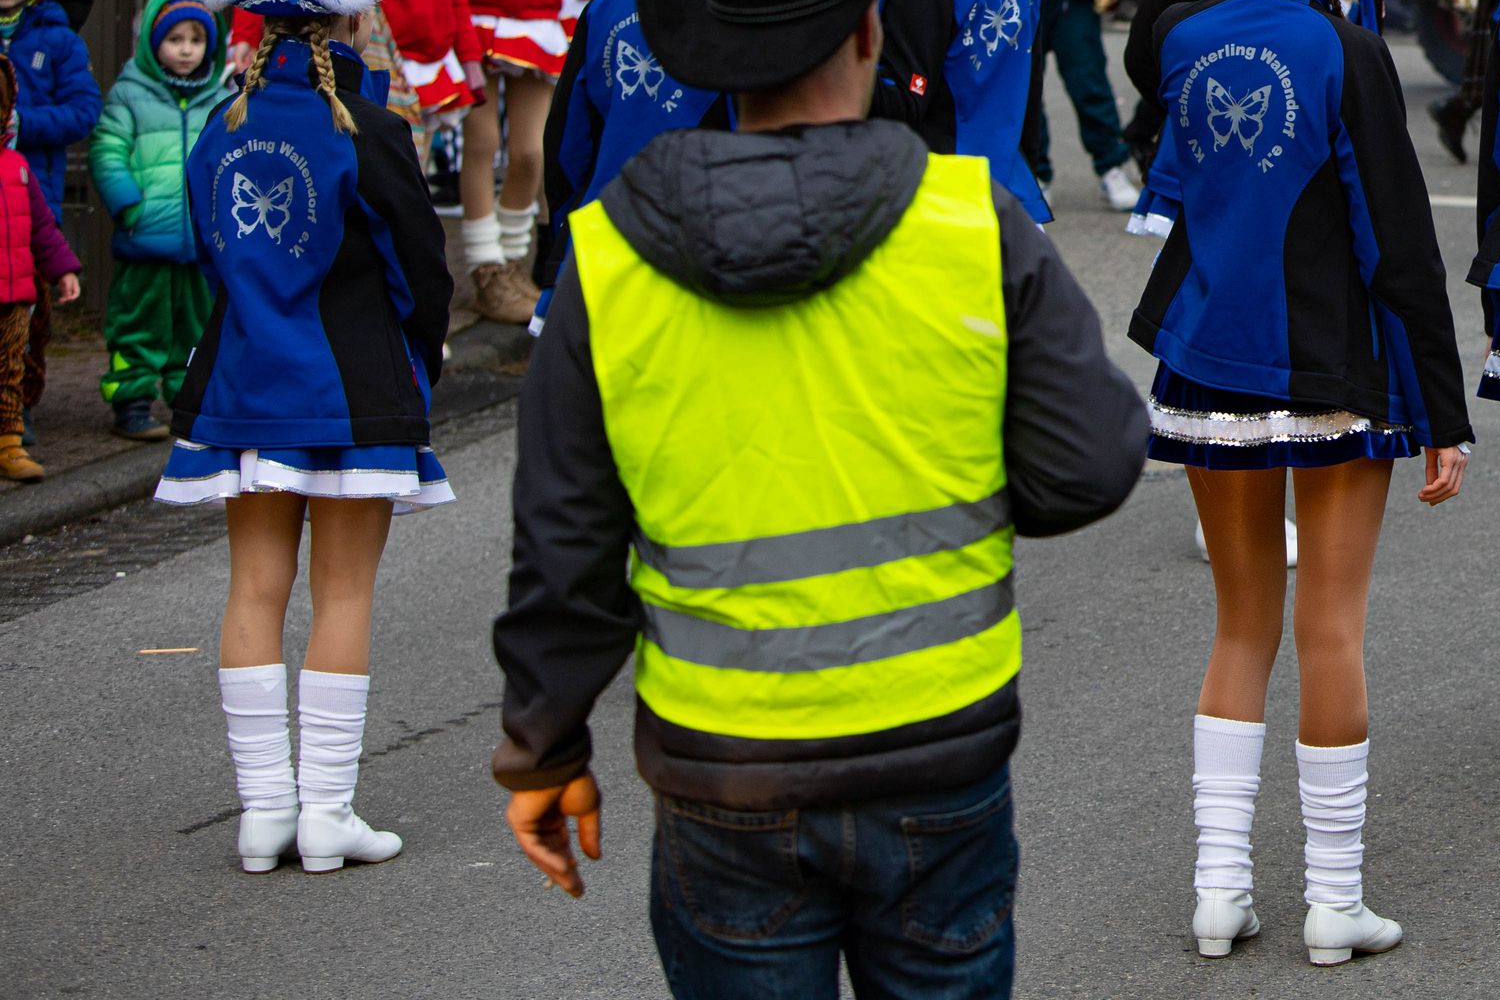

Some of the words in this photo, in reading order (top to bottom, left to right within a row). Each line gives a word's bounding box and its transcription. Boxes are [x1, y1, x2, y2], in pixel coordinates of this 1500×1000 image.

[1178, 43, 1256, 128] Schmetterling
[1260, 47, 1300, 139] Wallendorf
[661, 88, 683, 113] e.V.
[1187, 138, 1205, 164] KV
[1257, 145, 1283, 173] e.V.
[279, 141, 317, 224] Wallendorf
[212, 230, 226, 252] KV
[289, 231, 309, 258] e.V.
